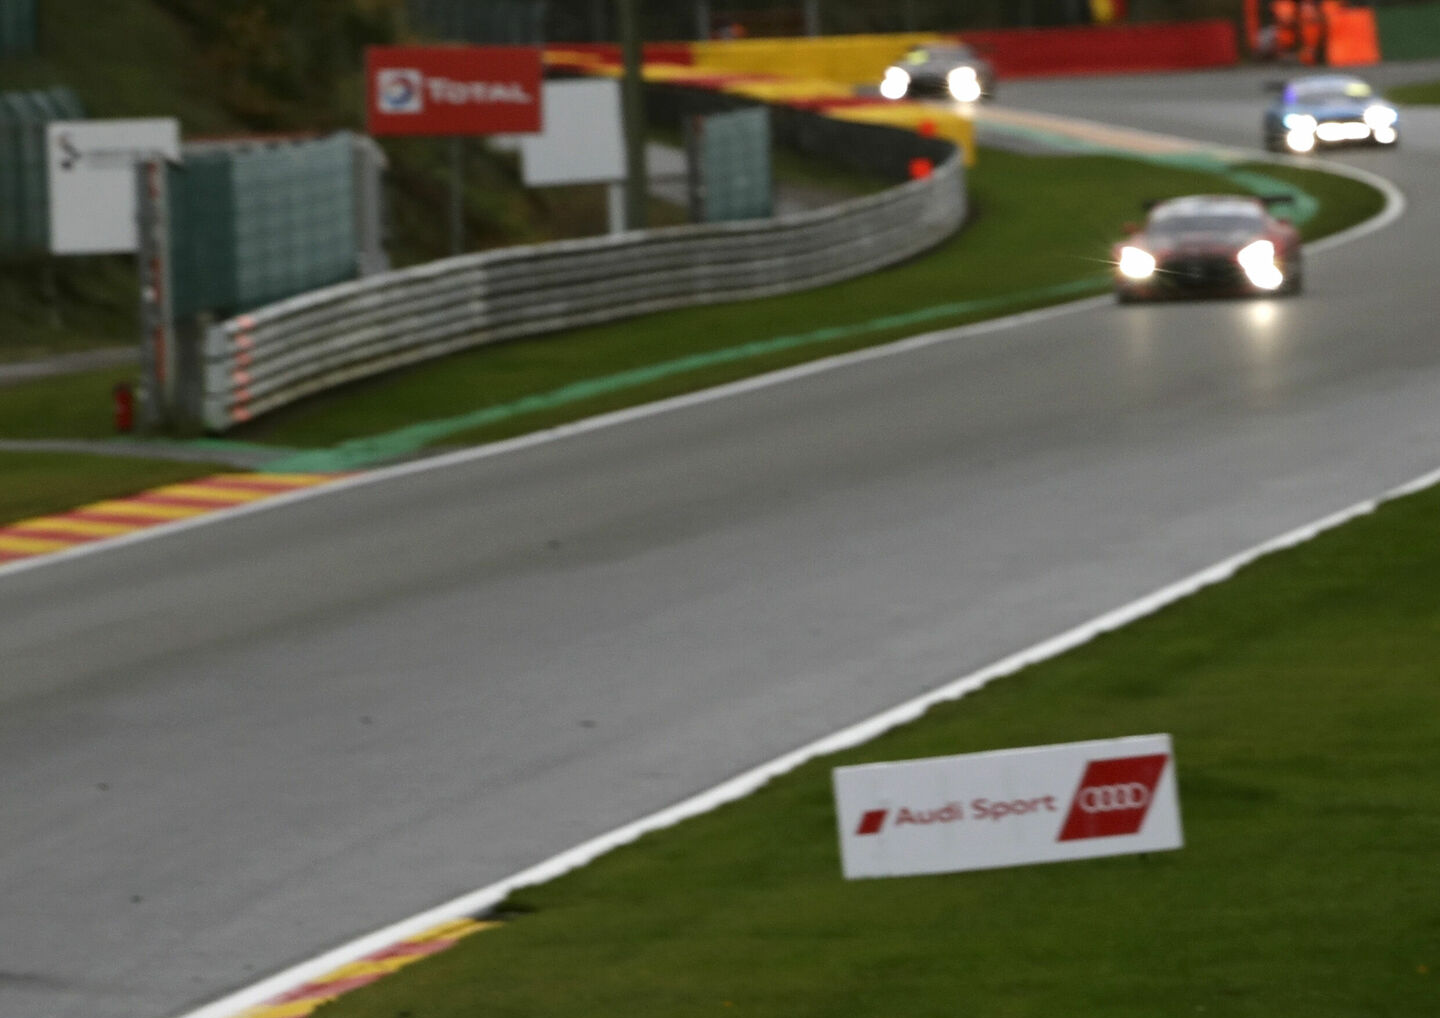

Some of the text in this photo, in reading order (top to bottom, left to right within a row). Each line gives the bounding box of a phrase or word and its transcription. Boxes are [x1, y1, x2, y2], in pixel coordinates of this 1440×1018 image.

[426, 77, 535, 104] TOTAL
[894, 795, 1058, 827] Audi Sport
